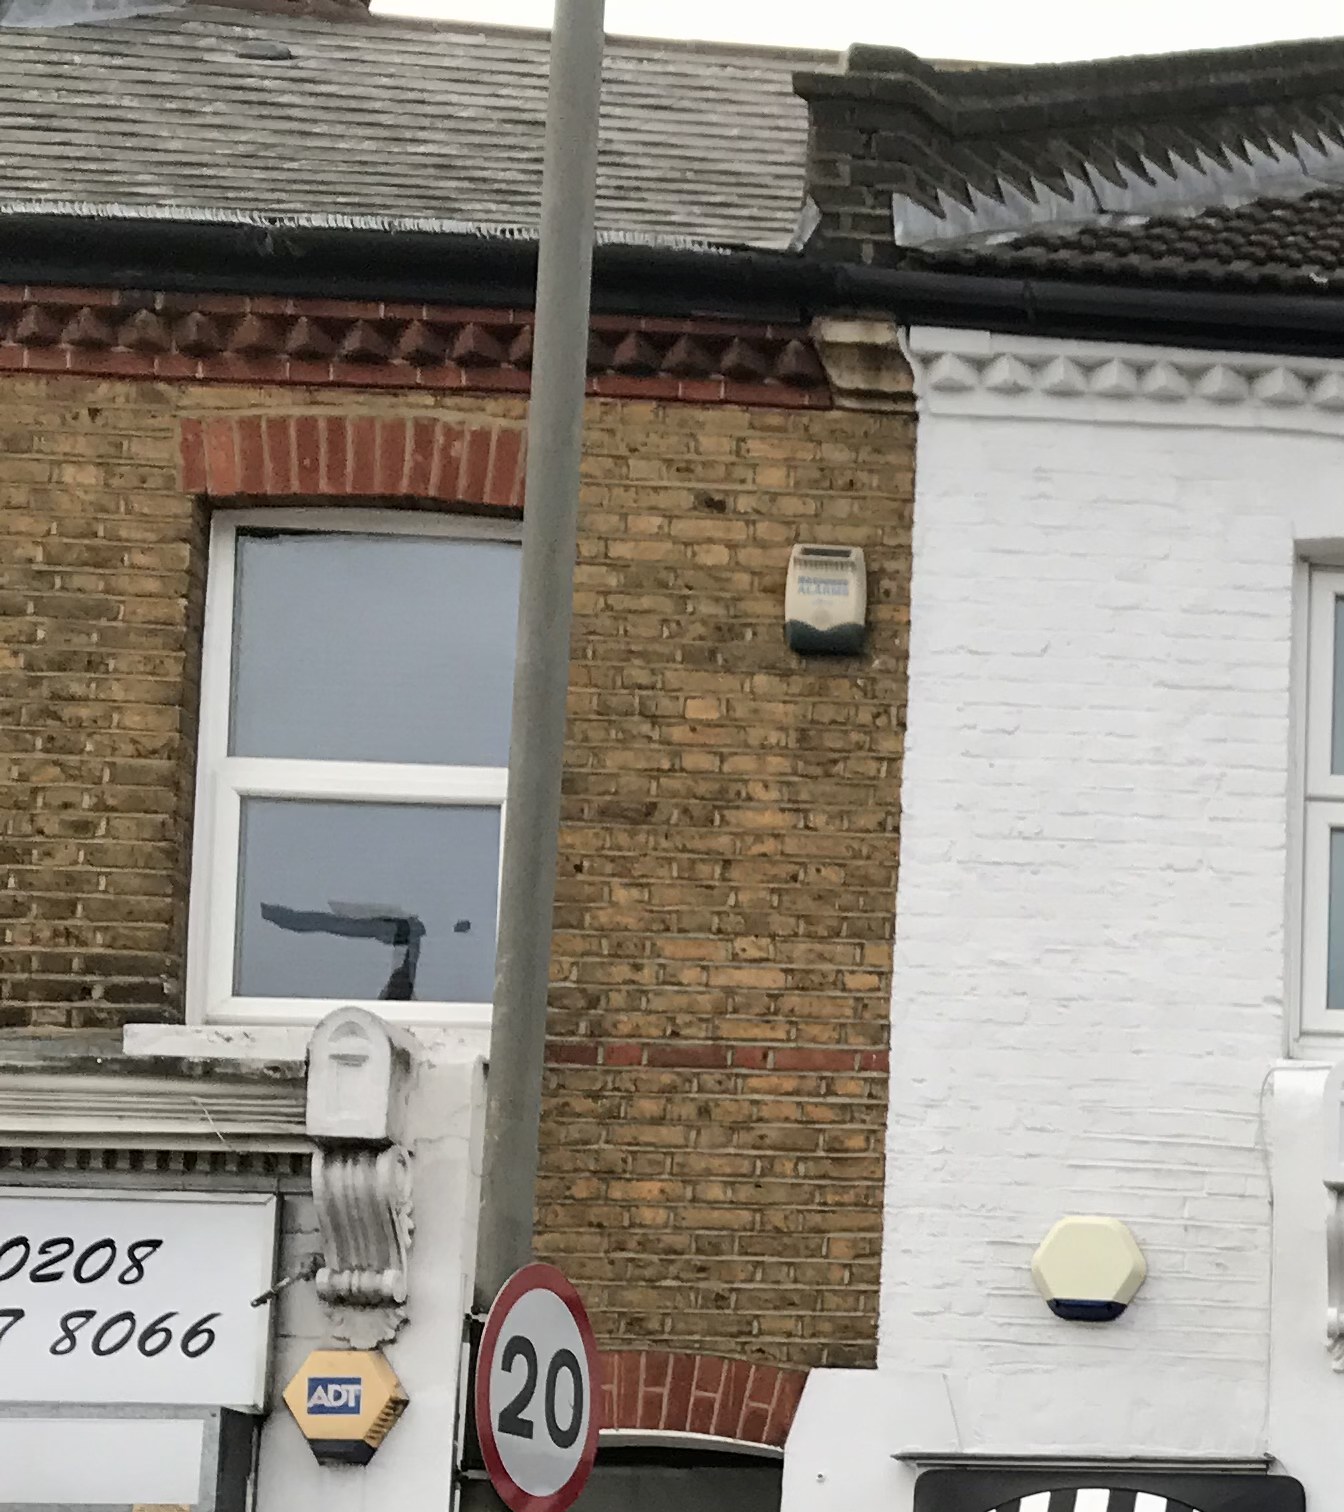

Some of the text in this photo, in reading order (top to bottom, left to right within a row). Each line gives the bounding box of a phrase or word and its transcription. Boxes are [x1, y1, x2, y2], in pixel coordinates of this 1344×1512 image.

[0, 1235, 164, 1286] 0208
[49, 1310, 224, 1358] 8066
[307, 1384, 361, 1408] ADT
[497, 1334, 584, 1450] 20
